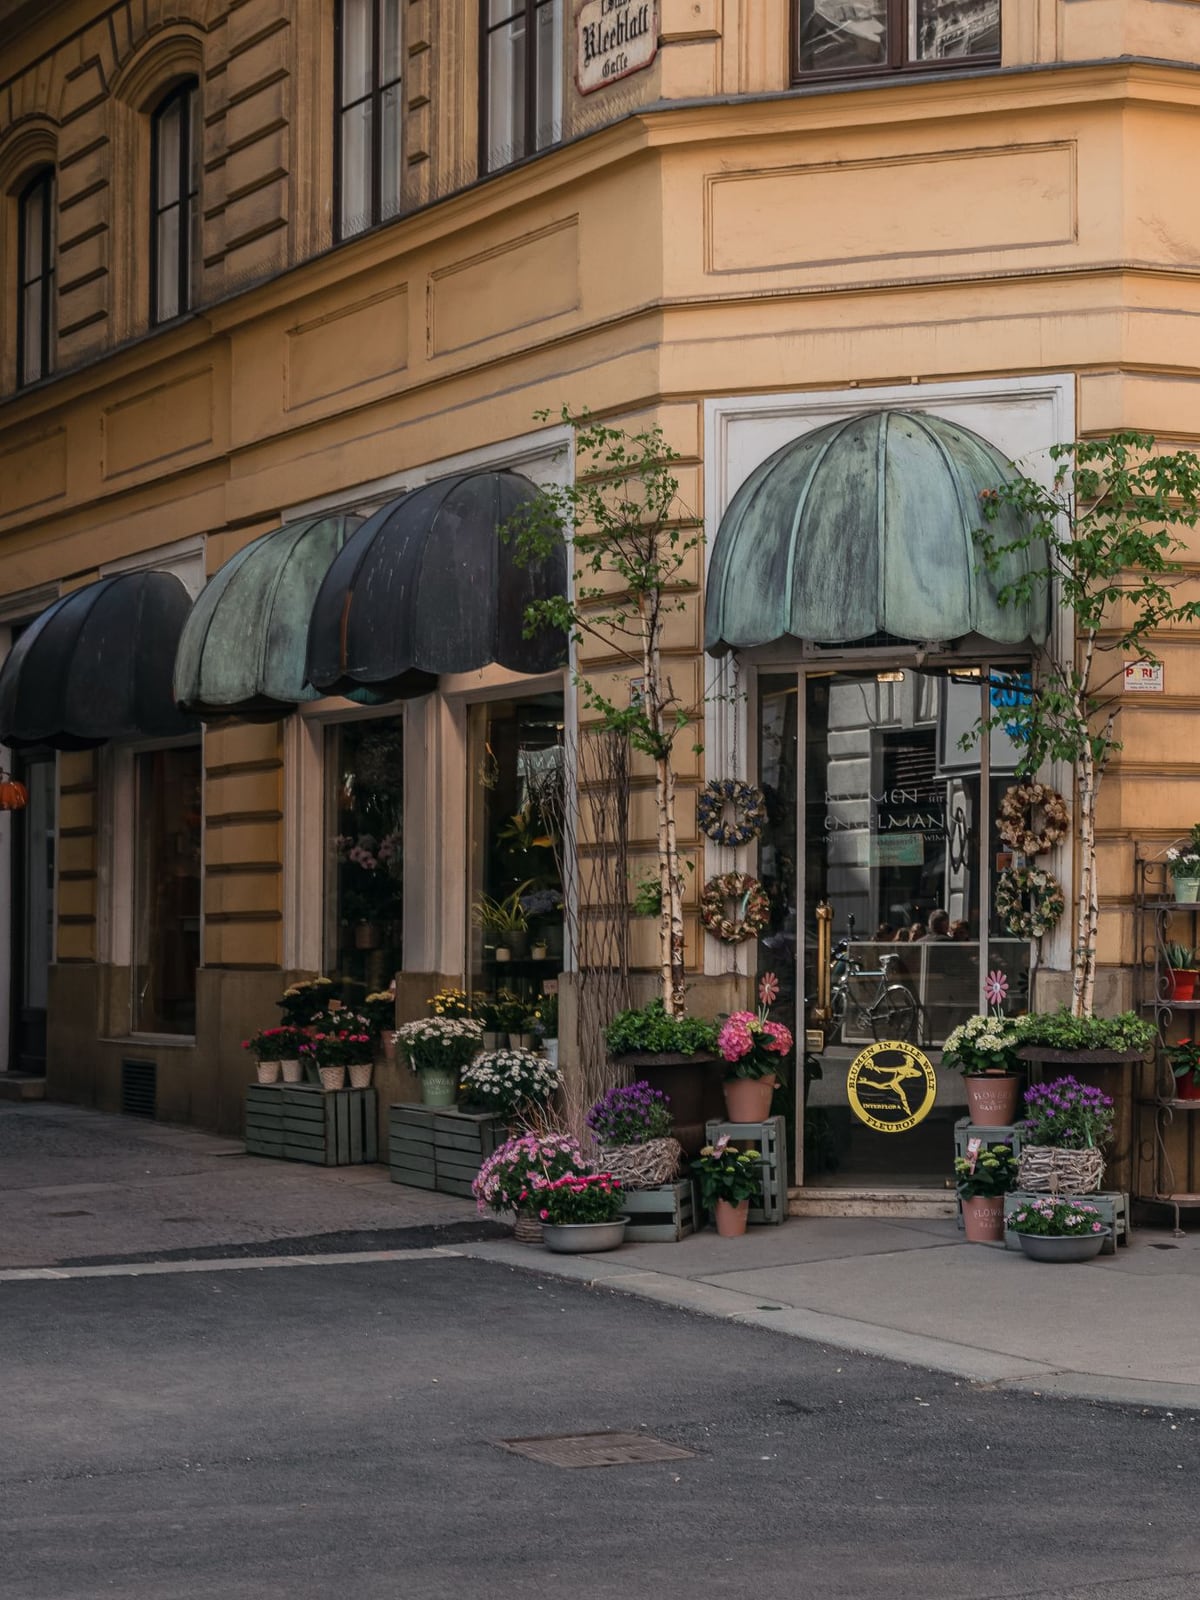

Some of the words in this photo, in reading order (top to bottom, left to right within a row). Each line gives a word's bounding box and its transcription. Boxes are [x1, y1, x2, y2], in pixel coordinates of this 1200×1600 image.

[582, 4, 649, 67] Kleeblatt
[848, 1047, 875, 1089] BLUMEN
[878, 1042, 892, 1050] IN
[895, 1042, 923, 1059] ALLE
[922, 1060, 935, 1091] WELT
[866, 1116, 916, 1132] FLEUROP
